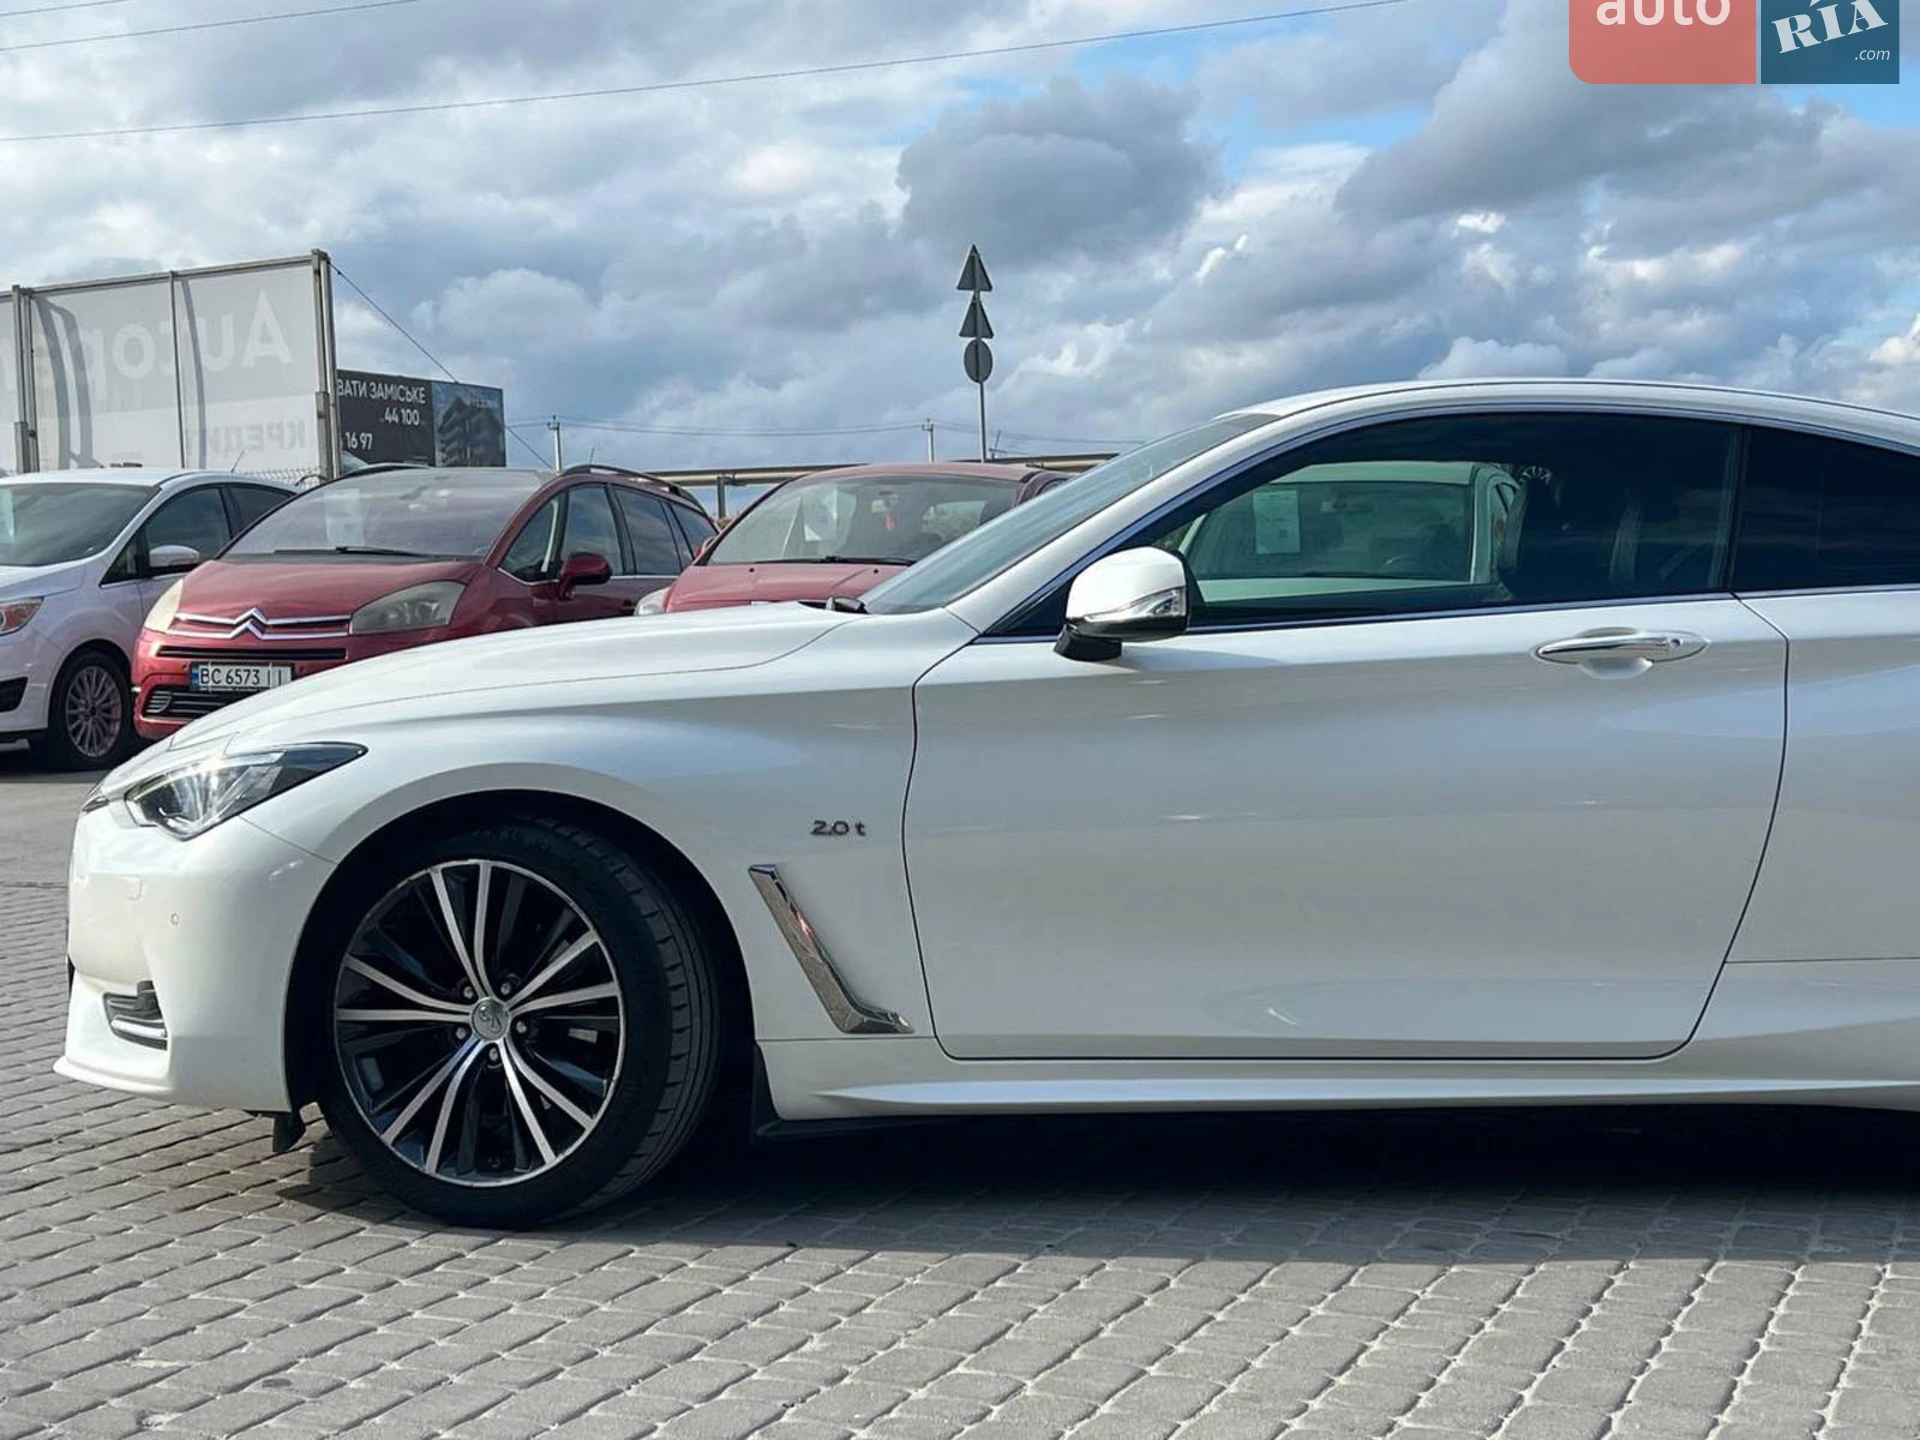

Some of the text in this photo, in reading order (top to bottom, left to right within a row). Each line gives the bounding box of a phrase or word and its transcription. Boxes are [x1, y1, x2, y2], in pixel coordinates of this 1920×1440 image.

[369, 382, 426, 404] ЗАМІСЬКЕ
[385, 407, 420, 426] 44 100
[345, 432, 373, 450] 16 97
[201, 668, 222, 685] BC
[226, 669, 260, 685] 6573
